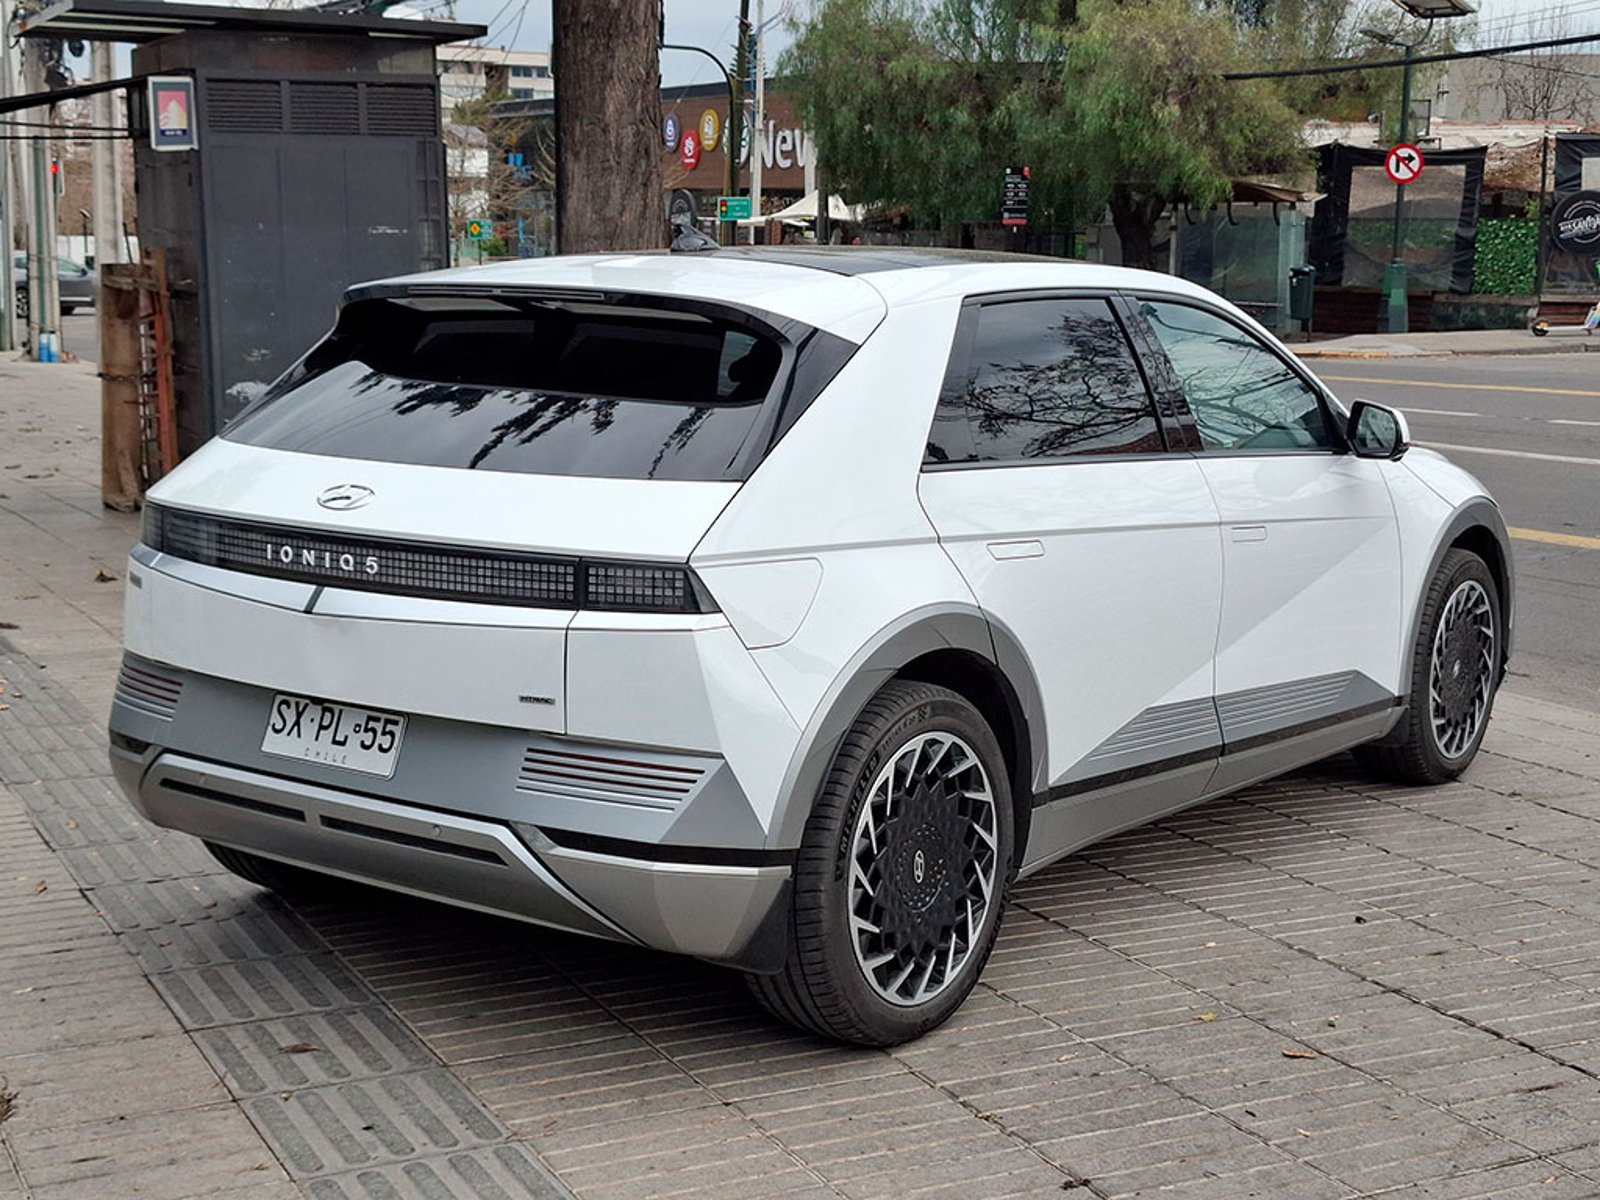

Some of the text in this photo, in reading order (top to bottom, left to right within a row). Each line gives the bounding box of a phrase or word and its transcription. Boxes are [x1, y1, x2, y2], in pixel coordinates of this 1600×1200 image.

[266, 543, 378, 574] IONIQ 5
[304, 747, 347, 765] CHILE
